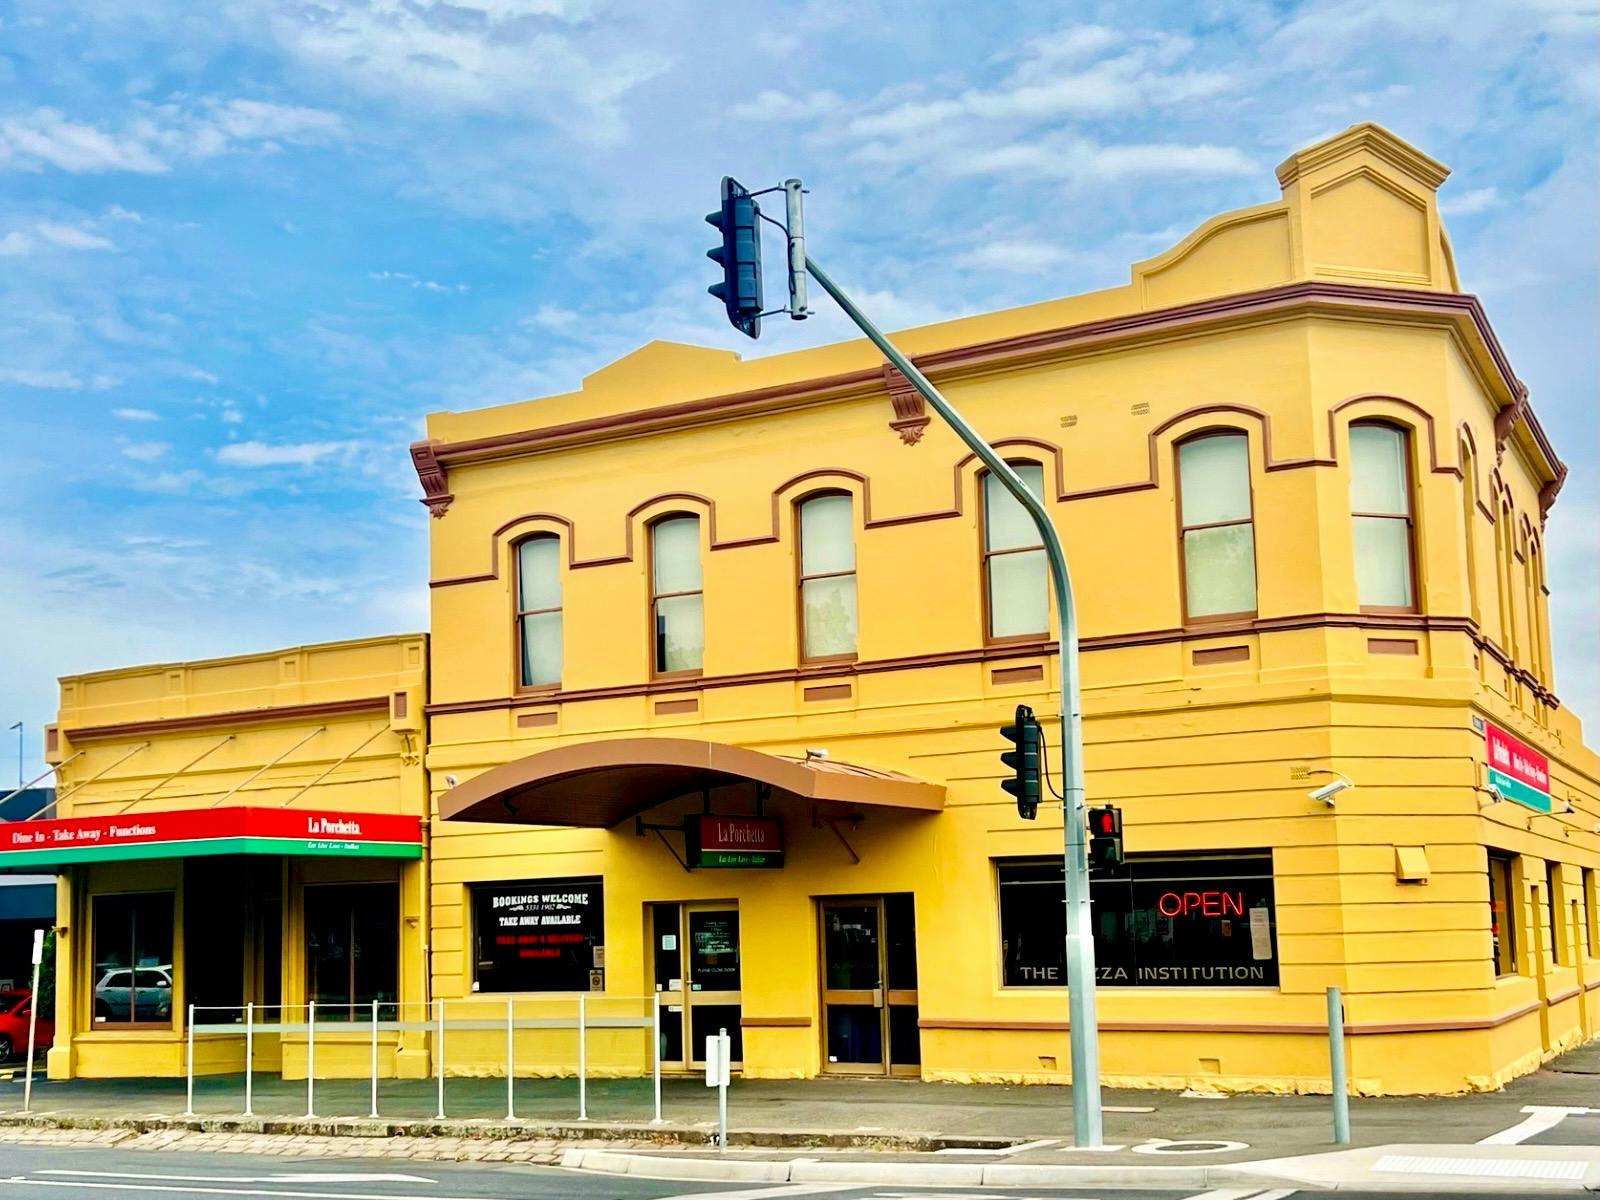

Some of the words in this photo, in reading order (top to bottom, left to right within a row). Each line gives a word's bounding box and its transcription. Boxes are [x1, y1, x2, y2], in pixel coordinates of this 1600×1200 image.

[12, 832, 33, 844] Dine
[35, 831, 46, 843] In
[52, 829, 75, 842] Take
[76, 828, 102, 842] Away
[109, 824, 157, 838] Functions
[308, 816, 320, 833] La
[320, 817, 361, 835] Porchetta
[718, 822, 729, 842] La
[730, 823, 765, 843] Porchetta
[492, 894, 539, 909] BOOKINGS
[541, 893, 589, 905] WELCOME
[1159, 891, 1244, 917] OPEN
[499, 916, 518, 926] TAKE
[519, 915, 539, 926] AWAY
[541, 914, 582, 925] AVAILABLE
[1020, 966, 1059, 980] THE
[1138, 966, 1264, 980] INSTITUTION
